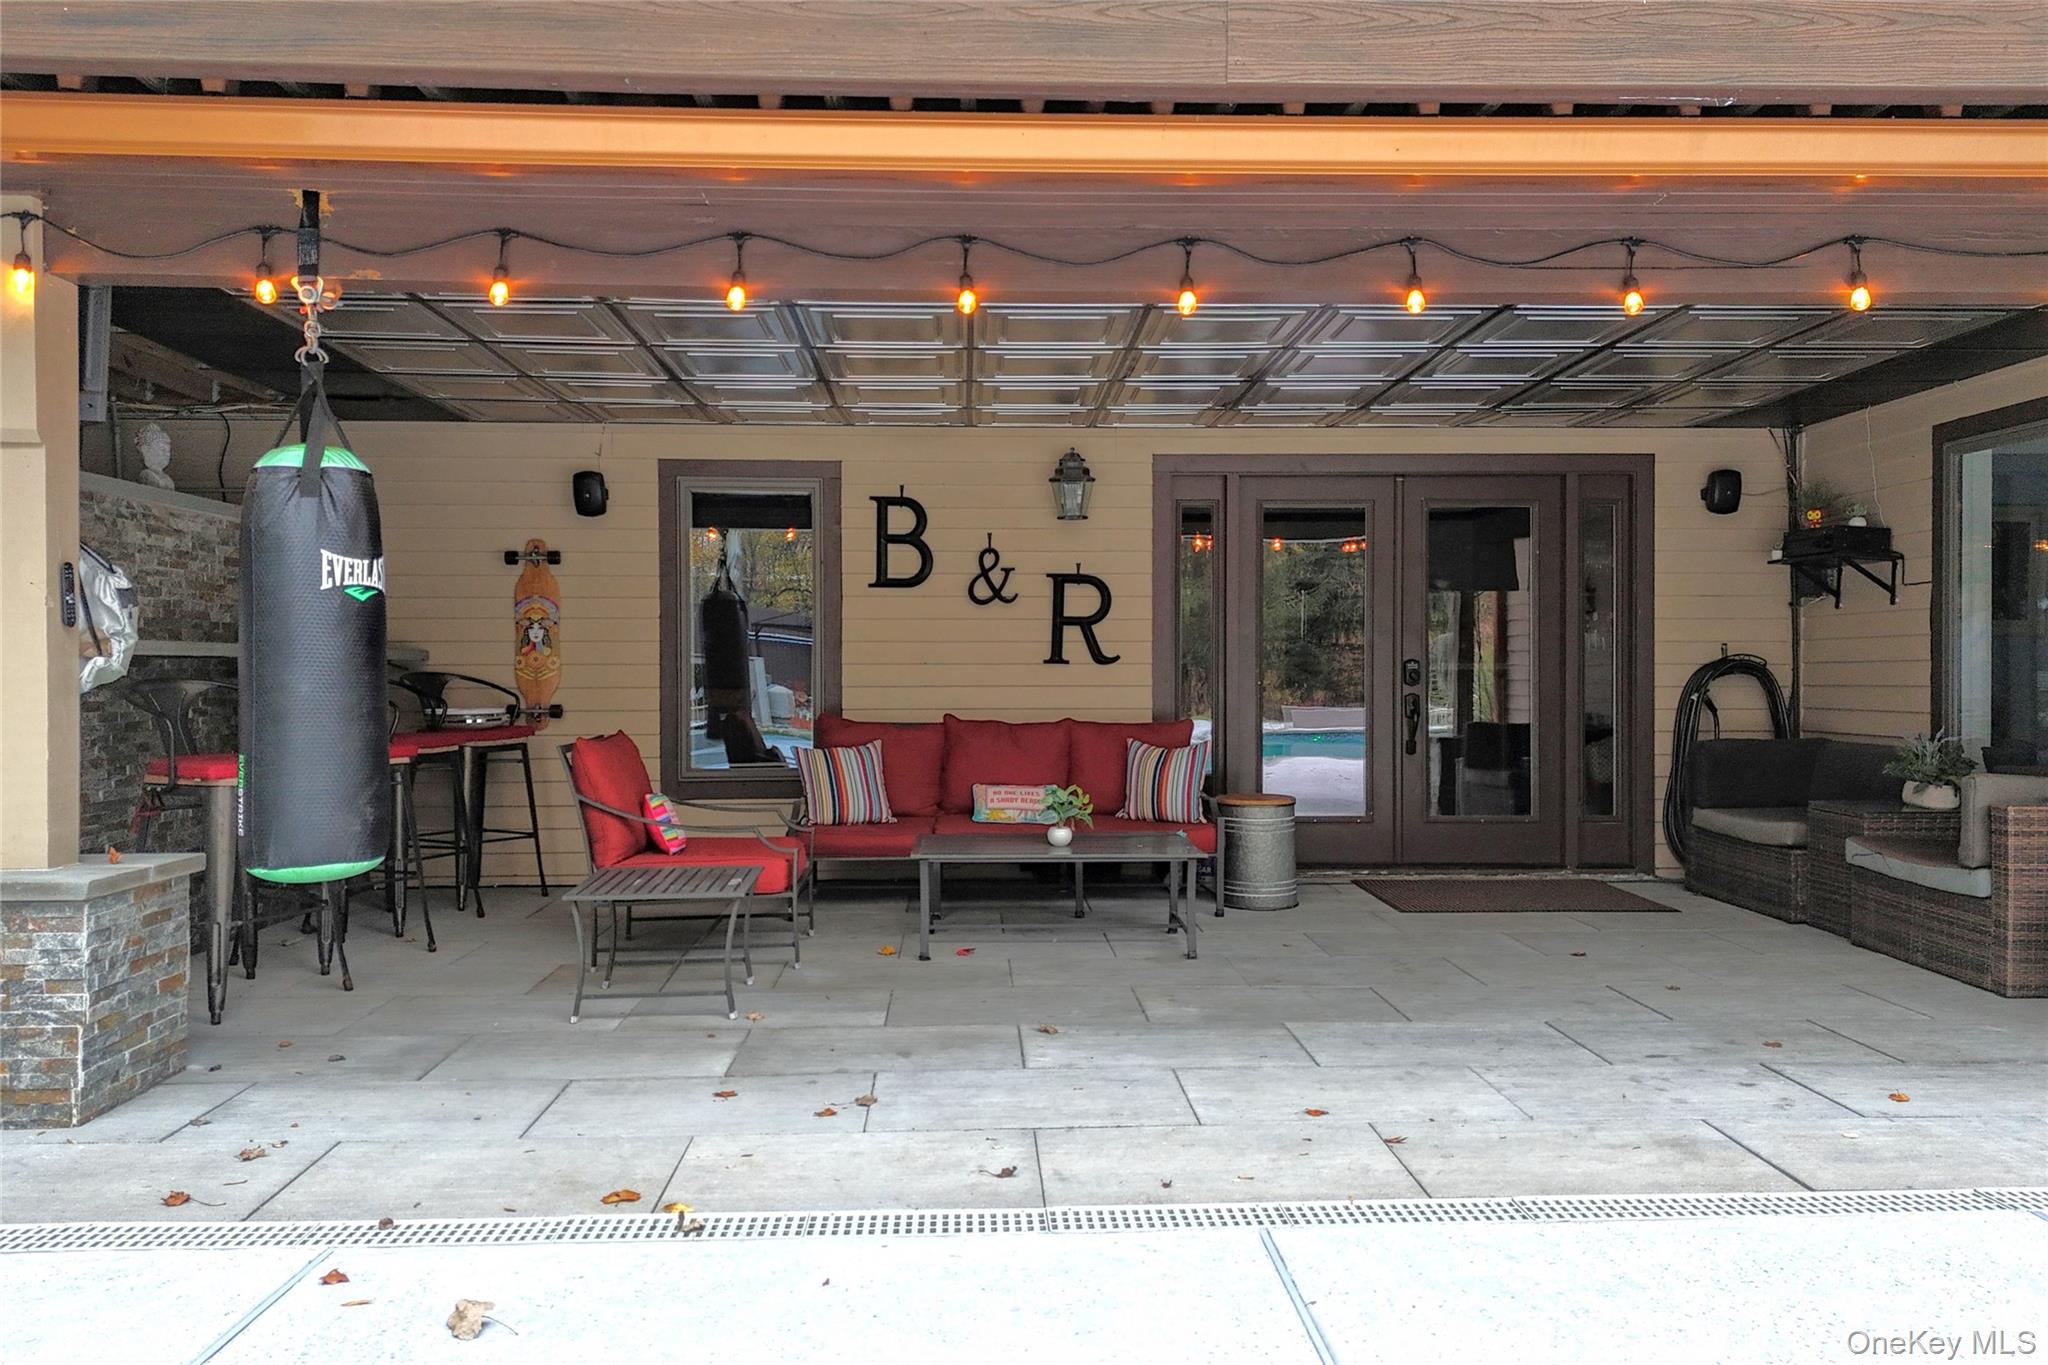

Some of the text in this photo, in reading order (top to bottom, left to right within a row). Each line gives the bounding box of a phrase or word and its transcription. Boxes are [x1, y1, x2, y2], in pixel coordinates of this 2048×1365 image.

[320, 548, 385, 592] EVERLAS
[868, 495, 1121, 665] B & R
